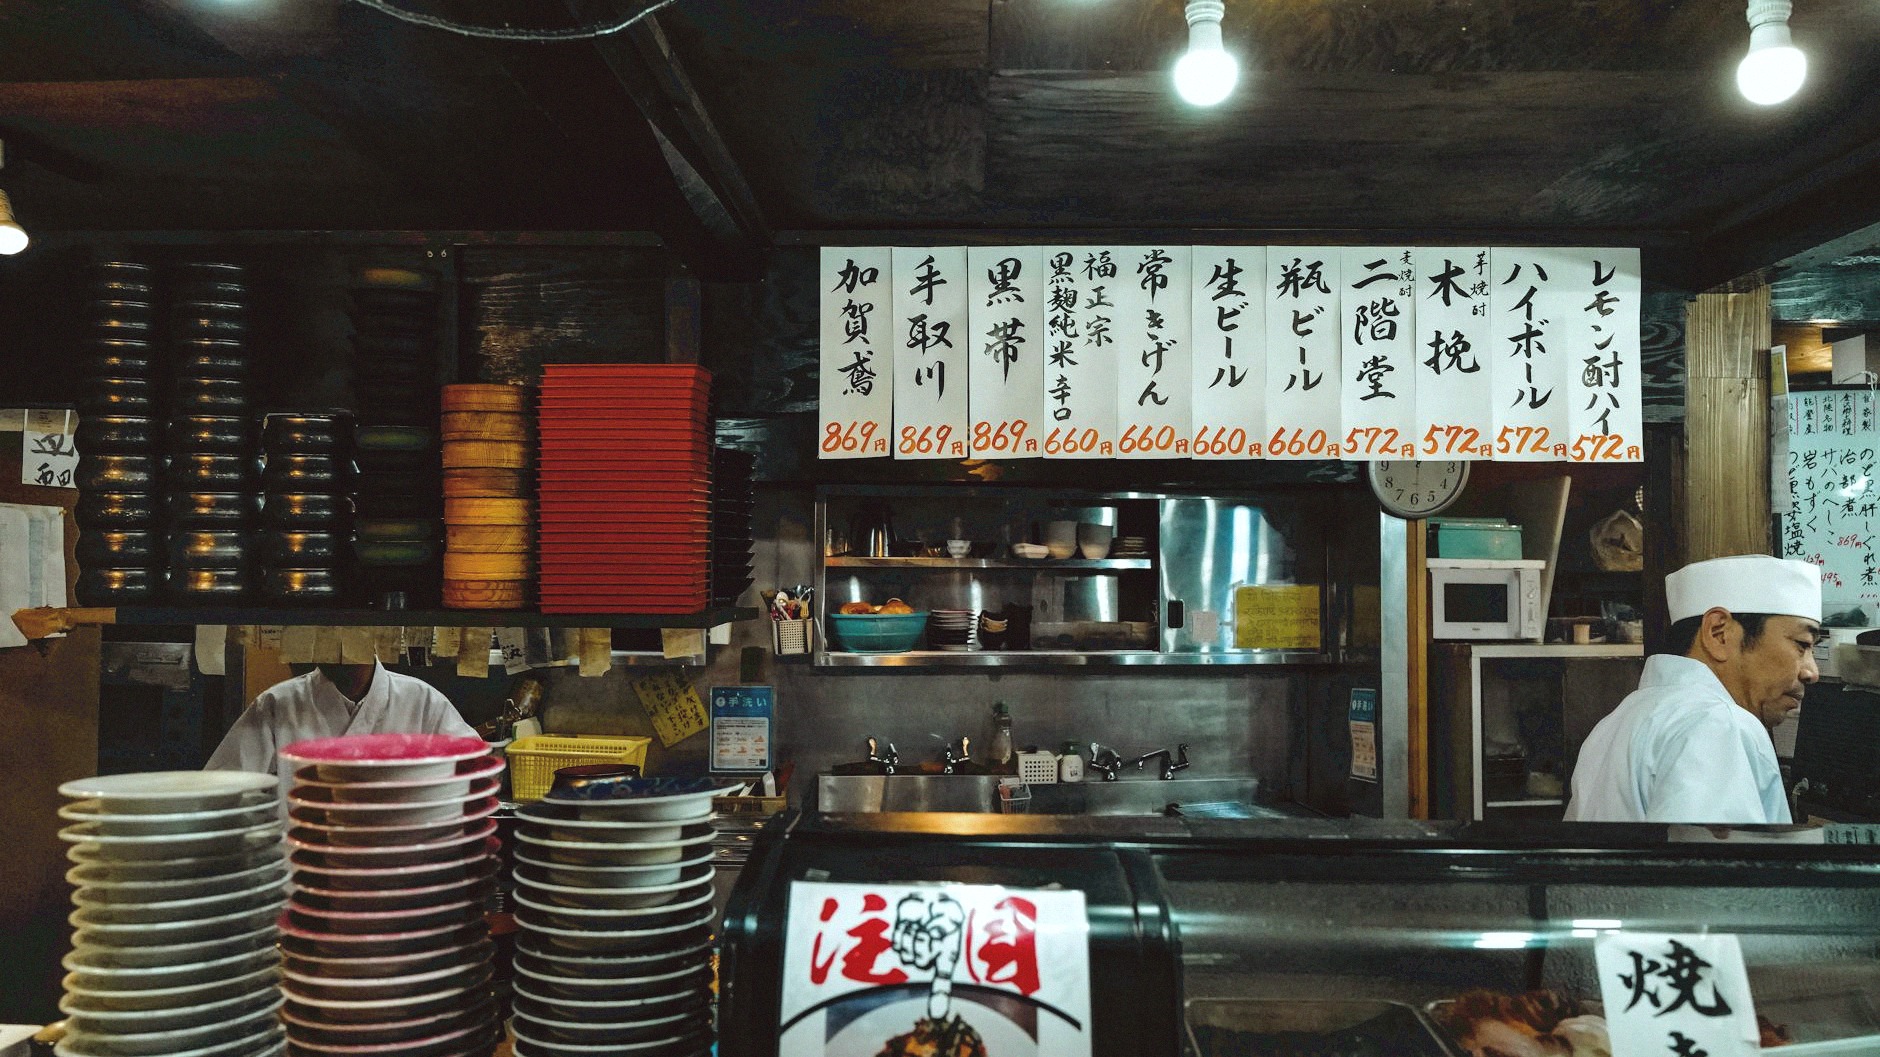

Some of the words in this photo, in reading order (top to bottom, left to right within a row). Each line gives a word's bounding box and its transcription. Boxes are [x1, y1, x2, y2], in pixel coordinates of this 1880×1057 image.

[1080, 250, 1117, 348] 福正宗
[1469, 252, 1489, 317] 芋焼酎
[831, 258, 879, 397] 加賀鳶
[906, 254, 953, 401] 手取川
[984, 257, 1026, 383] 黒帯
[1136, 249, 1177, 406] 常きげん
[1204, 257, 1249, 389] 生ビール
[1276, 257, 1332, 392] 瓶ビール
[1351, 258, 1400, 401] 二階堂
[1423, 258, 1480, 376] 木挽
[1501, 261, 1554, 410] ハイボール
[1581, 259, 1623, 436] レモン酎ハイ
[822, 421, 886, 453] 869円
[899, 425, 963, 456] 869円
[973, 419, 1038, 453] 869円
[1044, 427, 1113, 456] 660円
[1119, 425, 1189, 454] 660円
[1193, 426, 1262, 457] 660円
[1268, 427, 1340, 457] 660円
[1343, 427, 1415, 458] 572円
[1423, 424, 1492, 456] 572円
[1497, 426, 1567, 457] 572円
[1570, 434, 1641, 461] 572円
[1384, 476, 1393, 488] 8
[1447, 461, 1456, 473] 3
[1410, 493, 1419, 505] 6
[1427, 491, 1435, 502] 5
[1440, 478, 1447, 489] 4
[1802, 449, 1820, 533] 岩もずく
